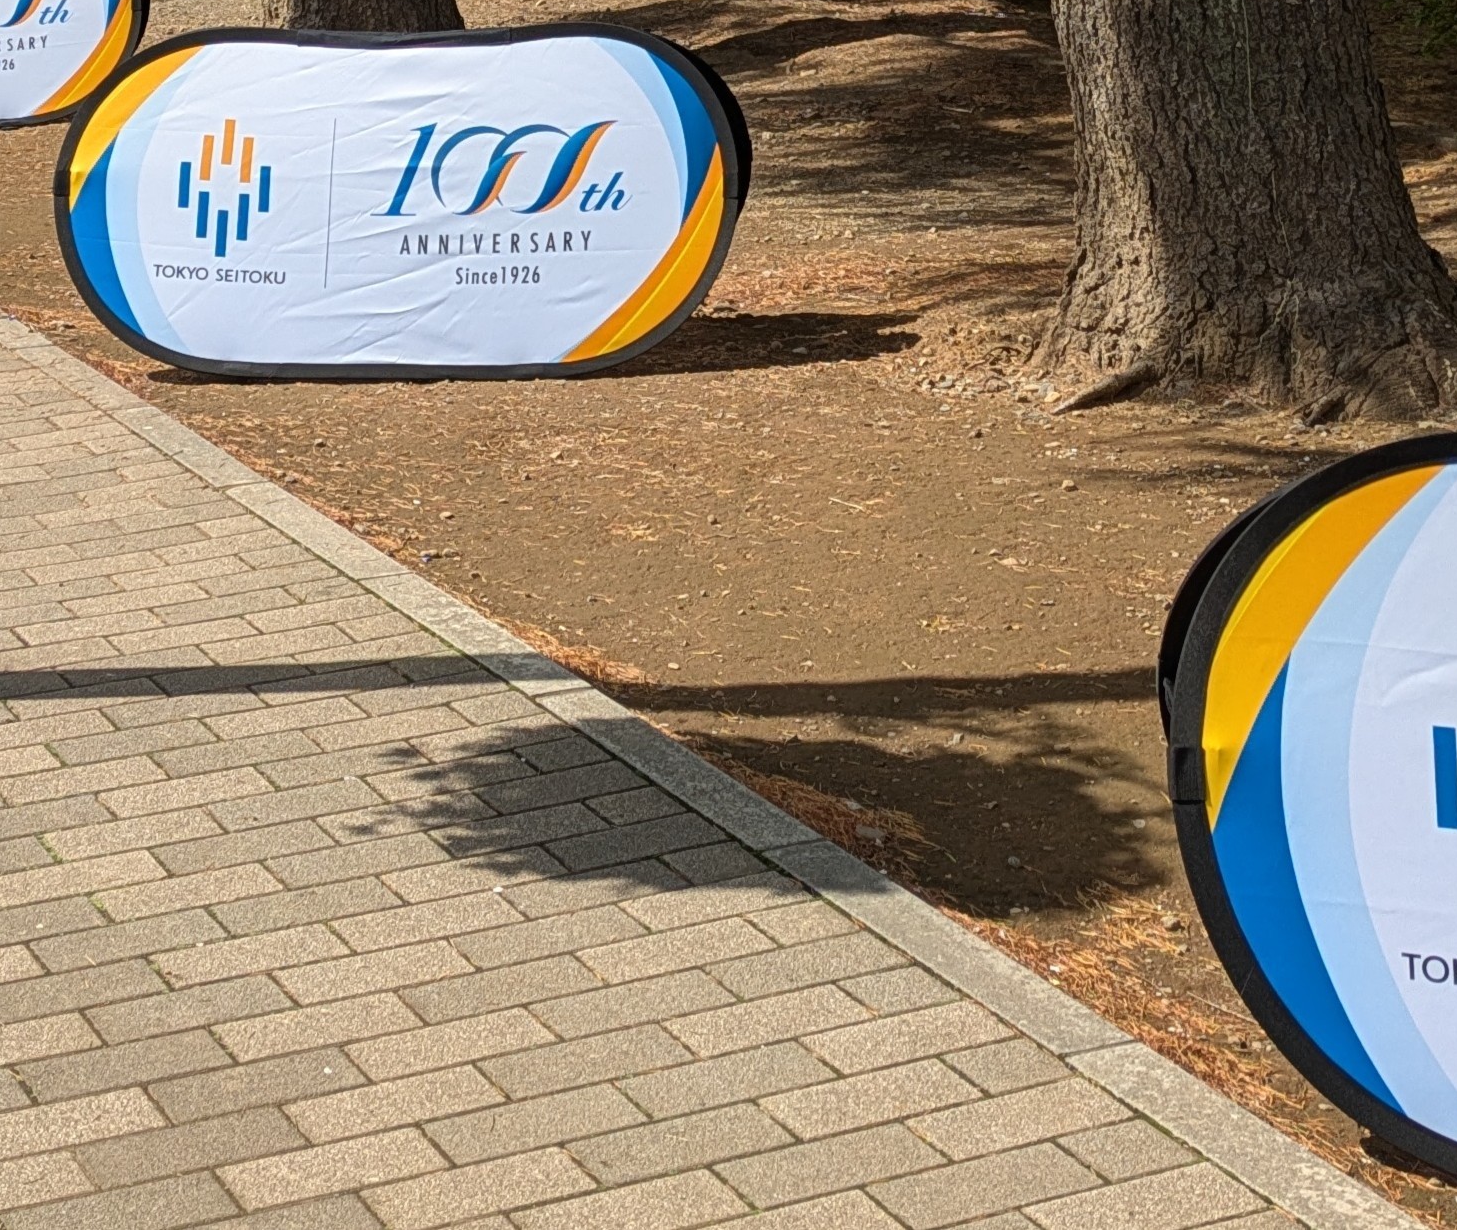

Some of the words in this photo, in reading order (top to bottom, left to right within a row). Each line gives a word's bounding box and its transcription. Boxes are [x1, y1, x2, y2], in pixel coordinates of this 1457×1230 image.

[372, 120, 633, 217] 100th
[400, 230, 593, 255] ANNIVERSARY
[153, 264, 209, 281] TOKYO
[216, 267, 286, 284] SEITOKU
[455, 266, 541, 285] Since1926
